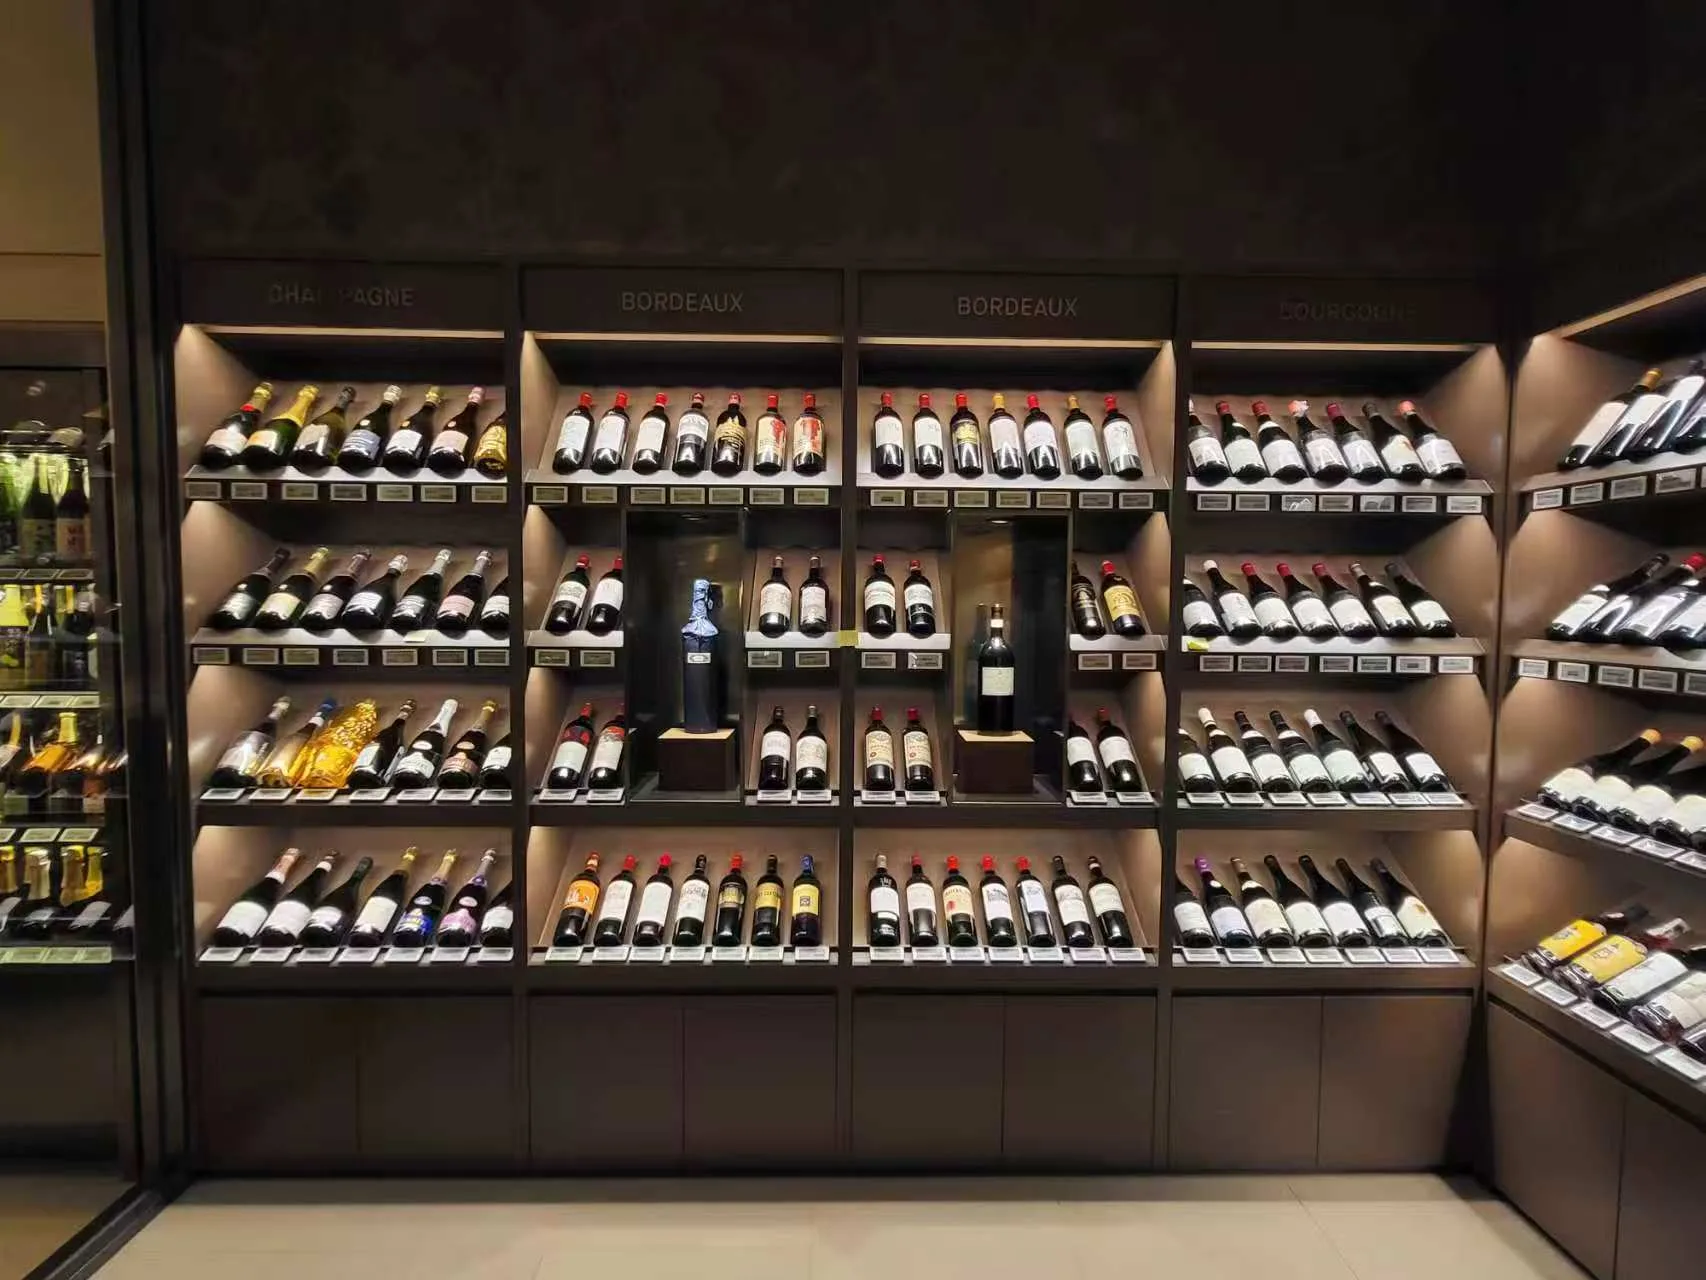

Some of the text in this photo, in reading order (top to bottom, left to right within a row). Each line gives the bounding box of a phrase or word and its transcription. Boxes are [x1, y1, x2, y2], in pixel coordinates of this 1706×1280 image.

[268, 284, 416, 307] CHAPAGNE
[621, 291, 744, 312] BORDEAUX
[957, 296, 1079, 316] BORDEAUX
